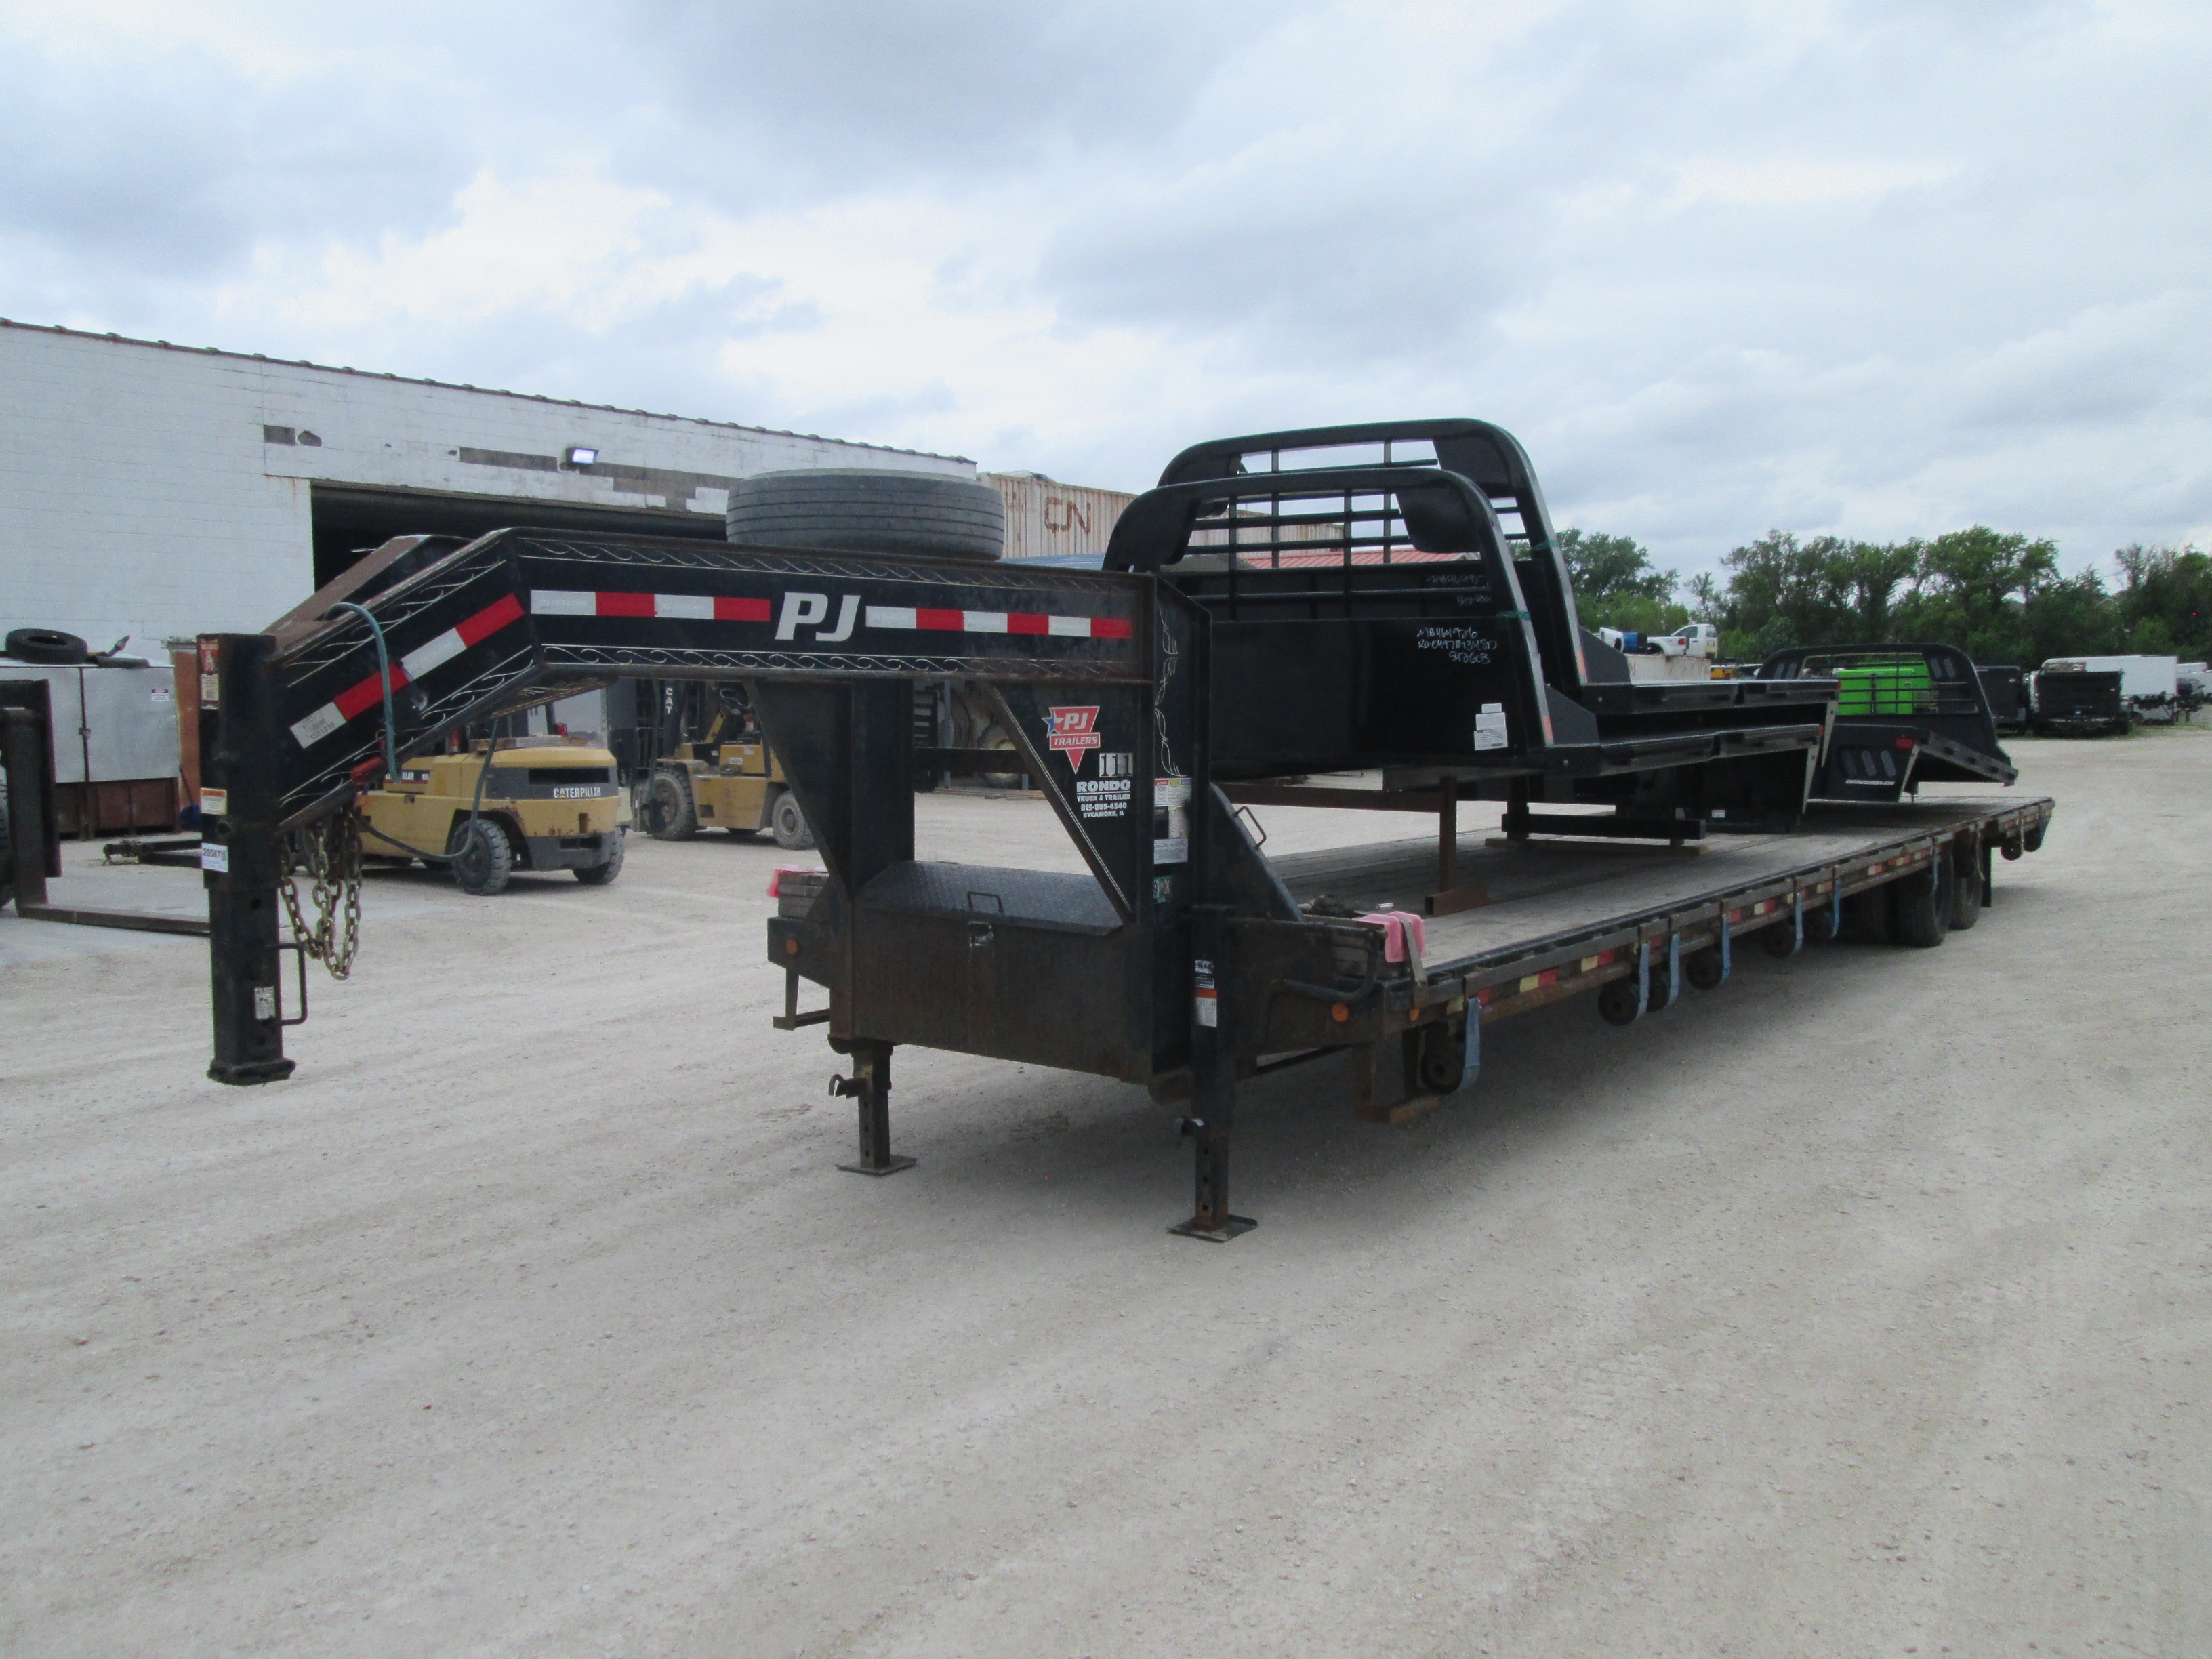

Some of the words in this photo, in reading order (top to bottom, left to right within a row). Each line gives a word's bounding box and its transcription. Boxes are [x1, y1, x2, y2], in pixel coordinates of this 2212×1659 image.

[1044, 496, 1091, 535] CN
[775, 592, 861, 641] PJ
[1063, 712, 1088, 730] PJ
[1053, 736, 1097, 746] TRAILERS
[1101, 754, 1132, 777] 111
[553, 786, 601, 798] CATERPILLAR
[1076, 779, 1131, 792] RONDO
[1105, 793, 1131, 801] TRAILER
